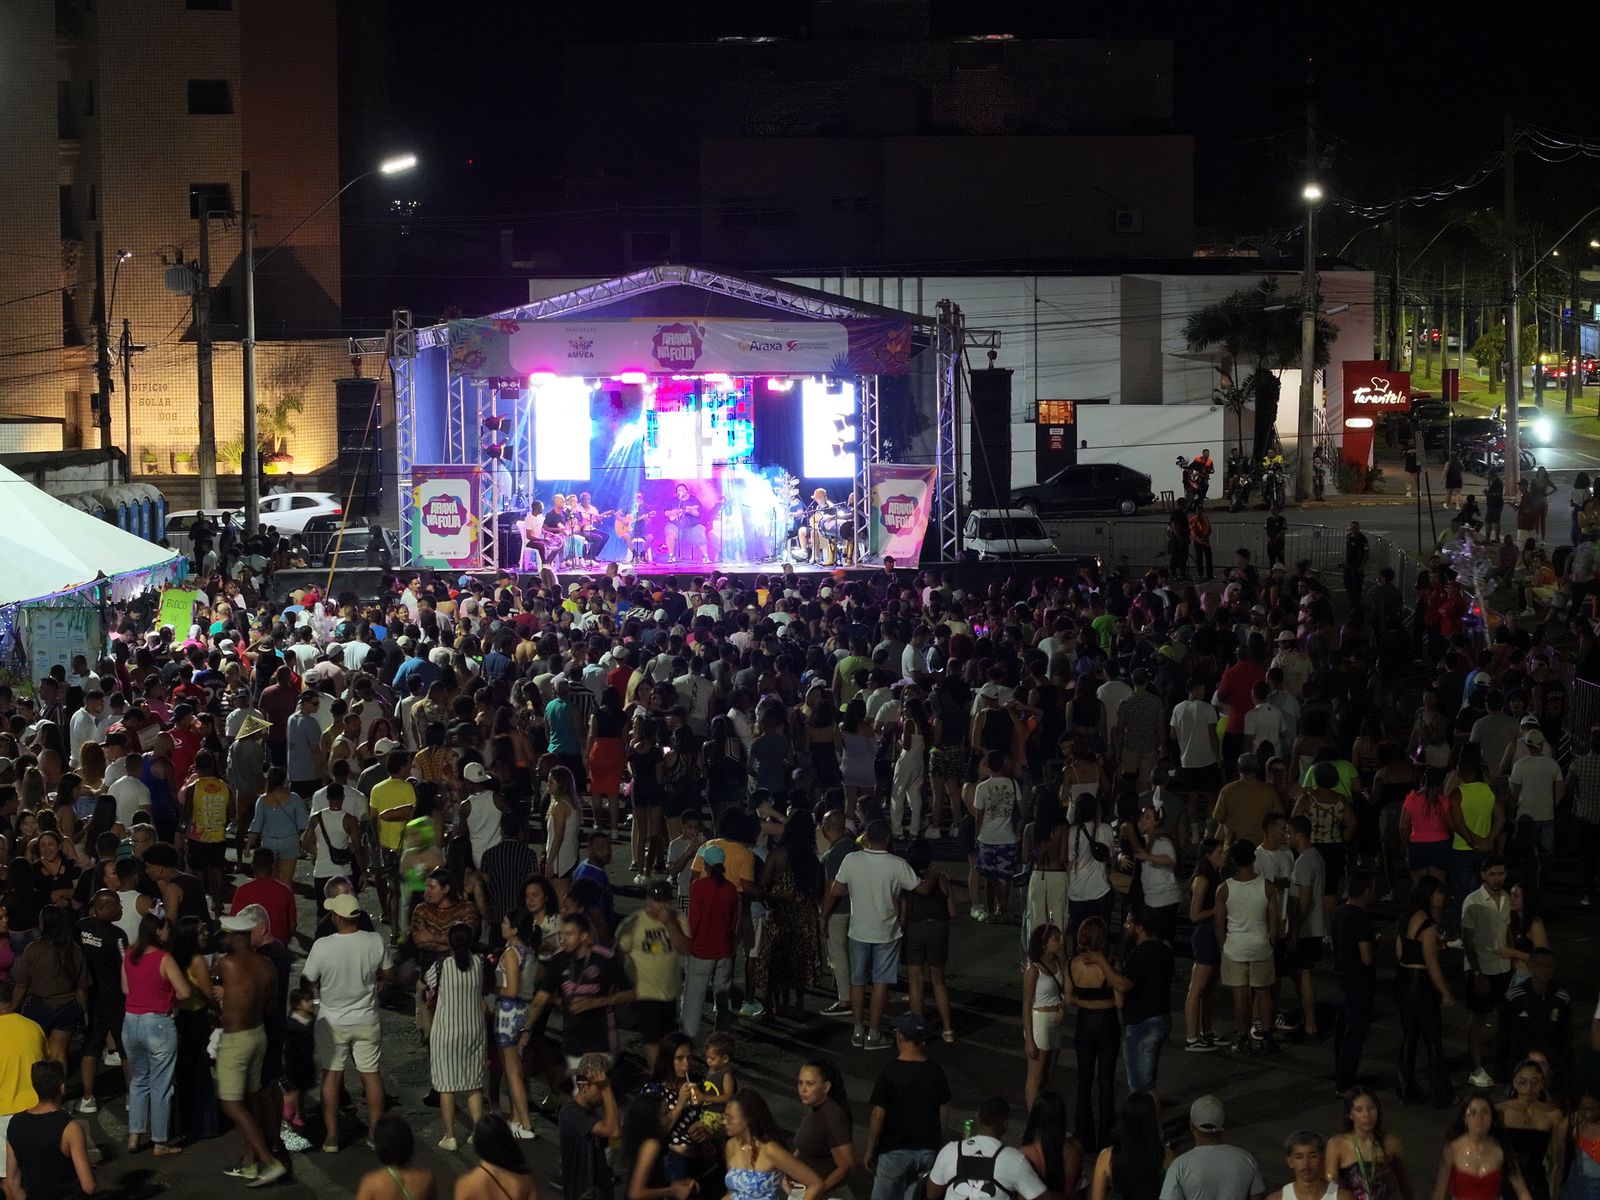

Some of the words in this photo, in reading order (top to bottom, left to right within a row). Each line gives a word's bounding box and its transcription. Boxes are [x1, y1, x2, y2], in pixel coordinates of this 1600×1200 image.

[657, 346, 671, 359] NA
[670, 346, 696, 362] FOLIA
[131, 383, 168, 392] DIFICIO
[138, 398, 171, 407] SOLAR
[1352, 387, 1407, 404] Tarantela
[430, 500, 459, 514] ARAXÁ
[426, 514, 438, 526] NA
[437, 514, 461, 529] FOLIA
